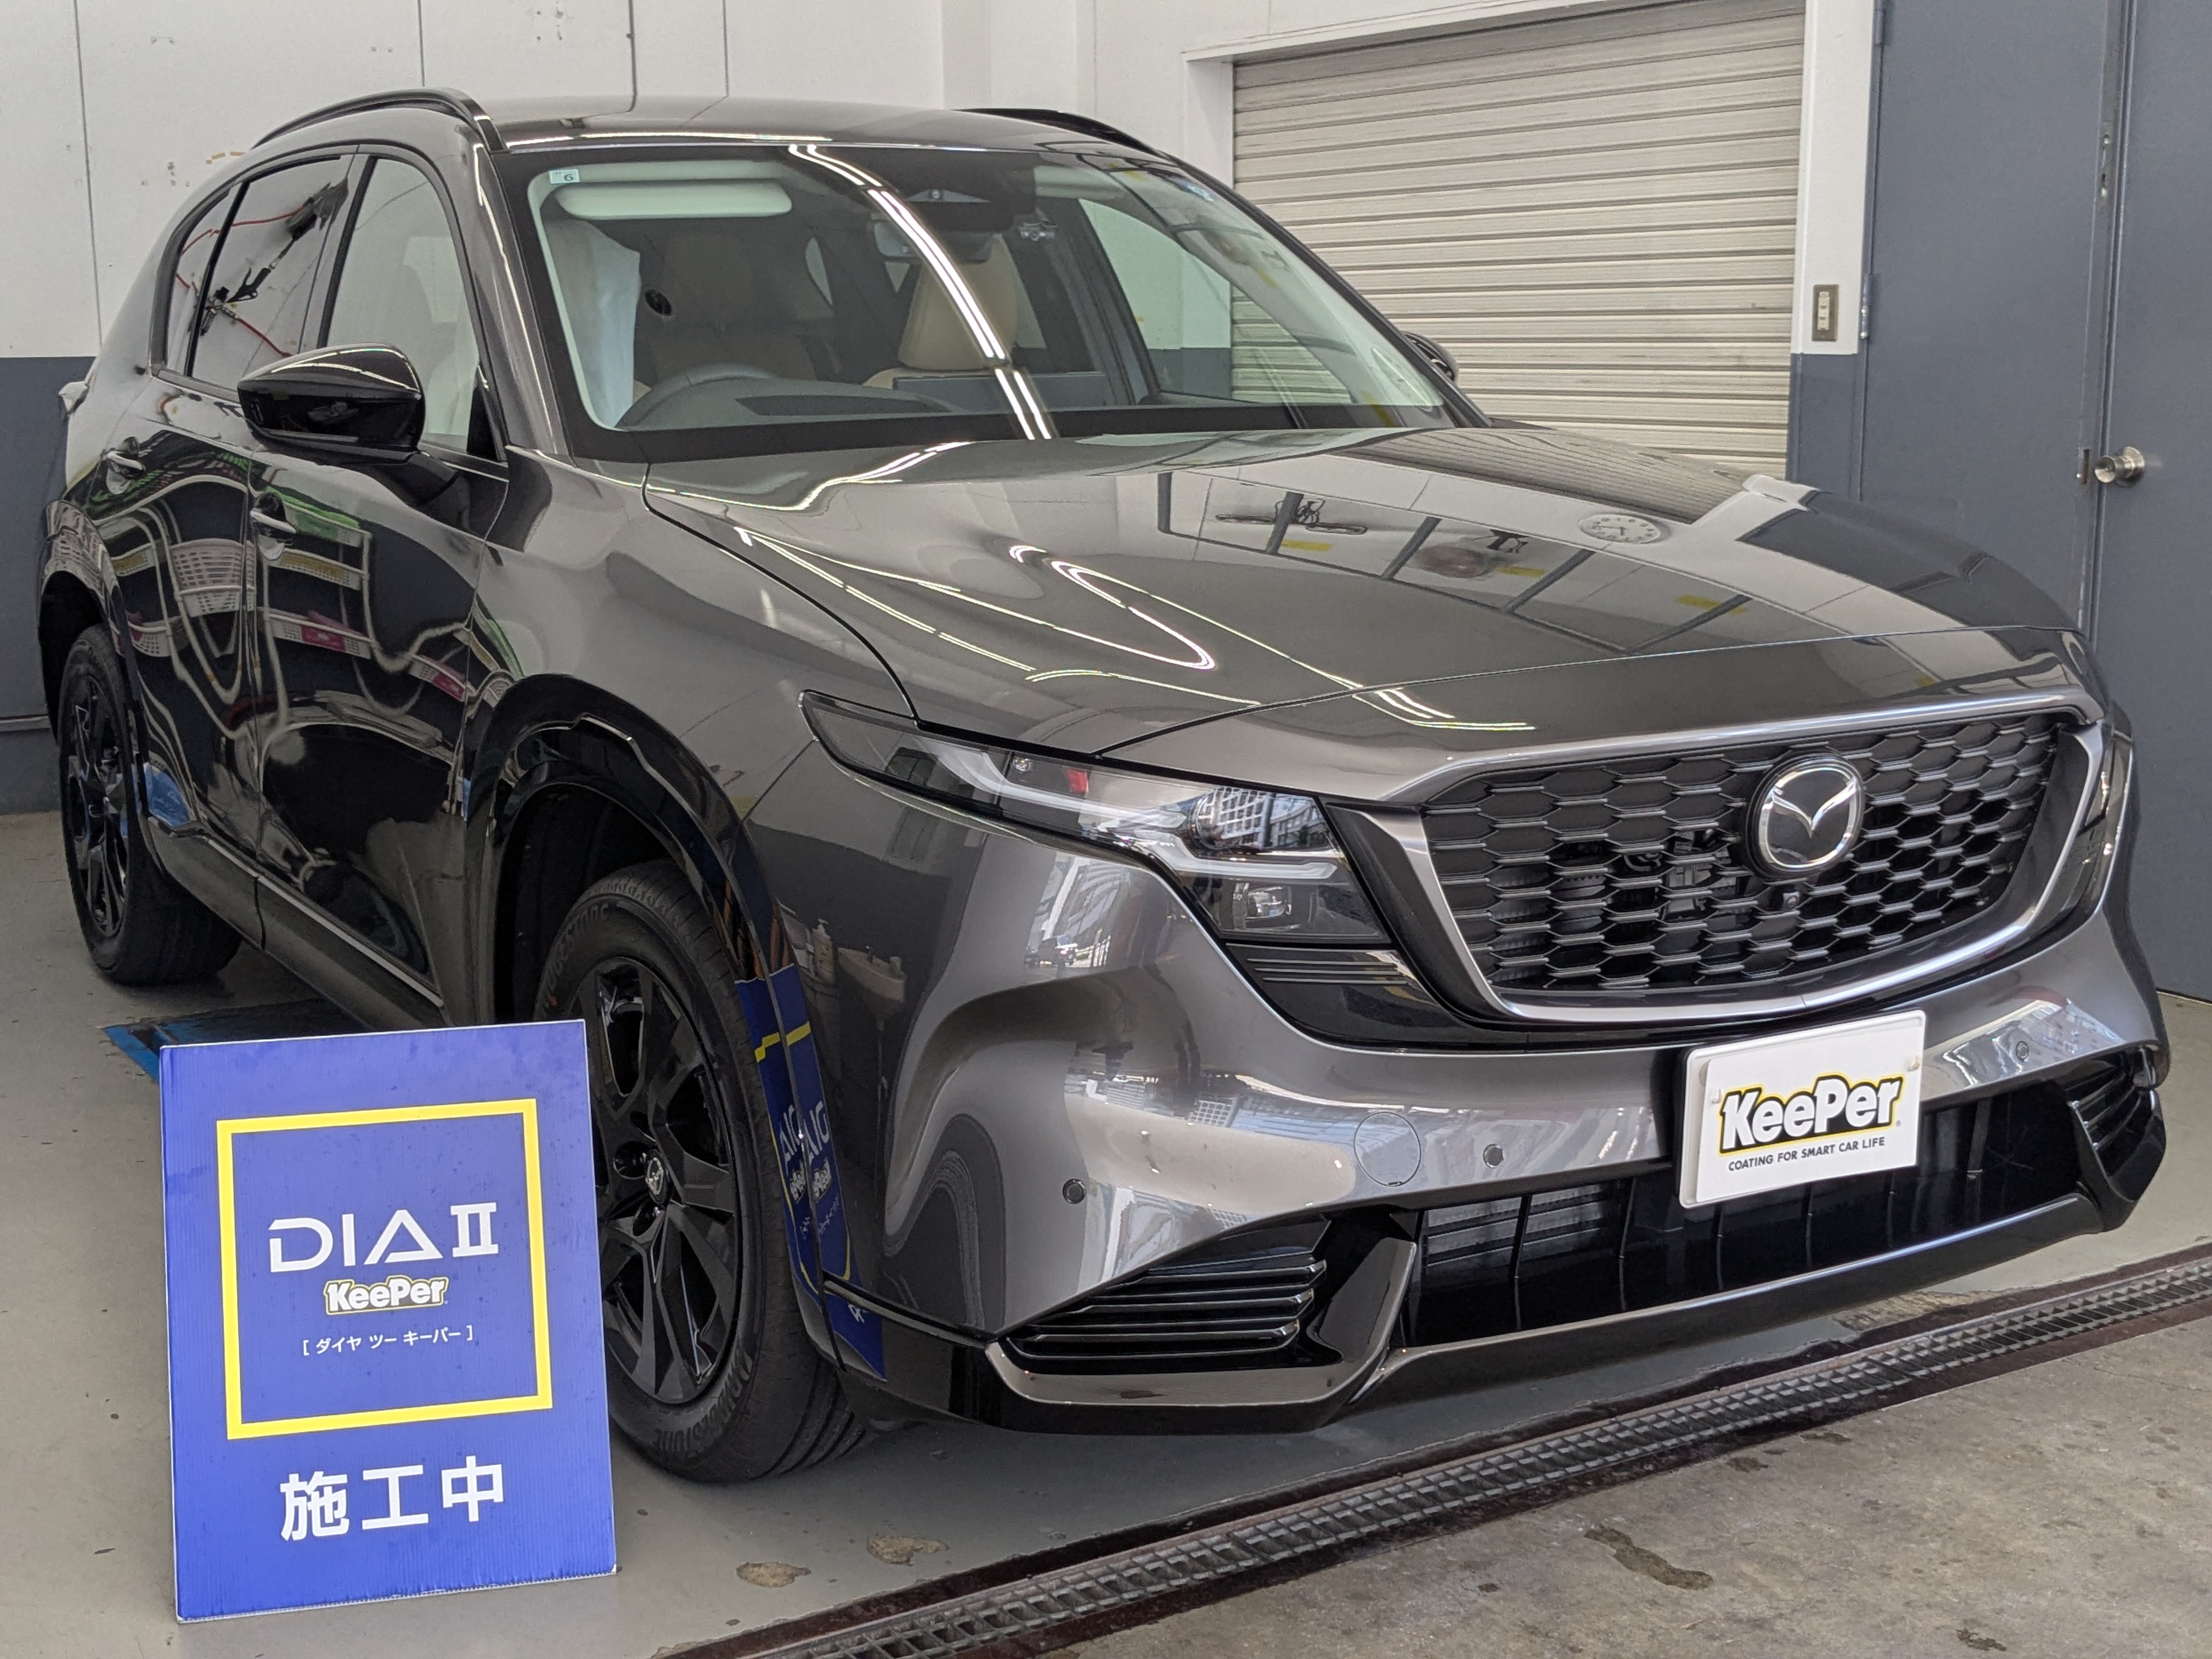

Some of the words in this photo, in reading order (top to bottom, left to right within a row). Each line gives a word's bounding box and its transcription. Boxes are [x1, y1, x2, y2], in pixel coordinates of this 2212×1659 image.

[1721, 1076, 1903, 1153] KeePer
[1728, 1154, 1774, 1171] COATING
[1777, 1150, 1798, 1163] FOR
[1801, 1144, 1836, 1159] SMART
[1838, 1140, 1859, 1153] CAR
[1862, 1136, 1886, 1149] LIFE
[268, 1209, 444, 1273] DIA
[325, 1276, 448, 1314] KeePer
[280, 1455, 504, 1542] 施工中
